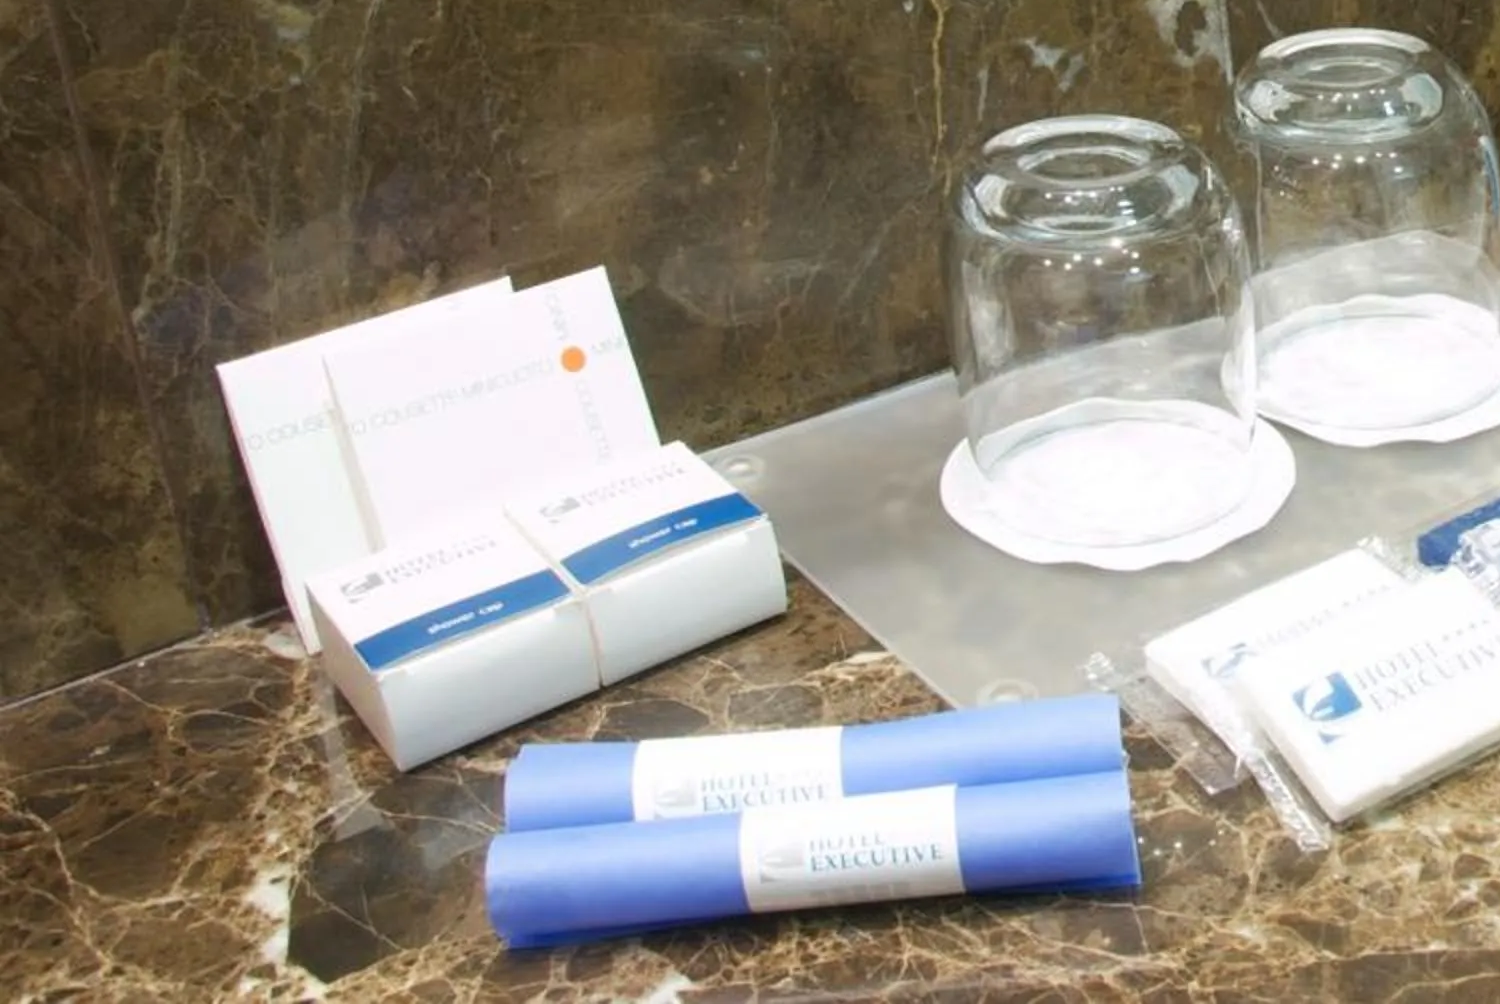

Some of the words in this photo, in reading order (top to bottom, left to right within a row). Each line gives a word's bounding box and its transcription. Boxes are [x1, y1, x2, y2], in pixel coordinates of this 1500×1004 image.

[1353, 640, 1441, 690] HOTEL
[700, 771, 771, 793] HOTEL
[702, 783, 828, 813] EXECUTIVE
[809, 831, 884, 852] HOTEL
[810, 842, 945, 873] EXECUTIVE
